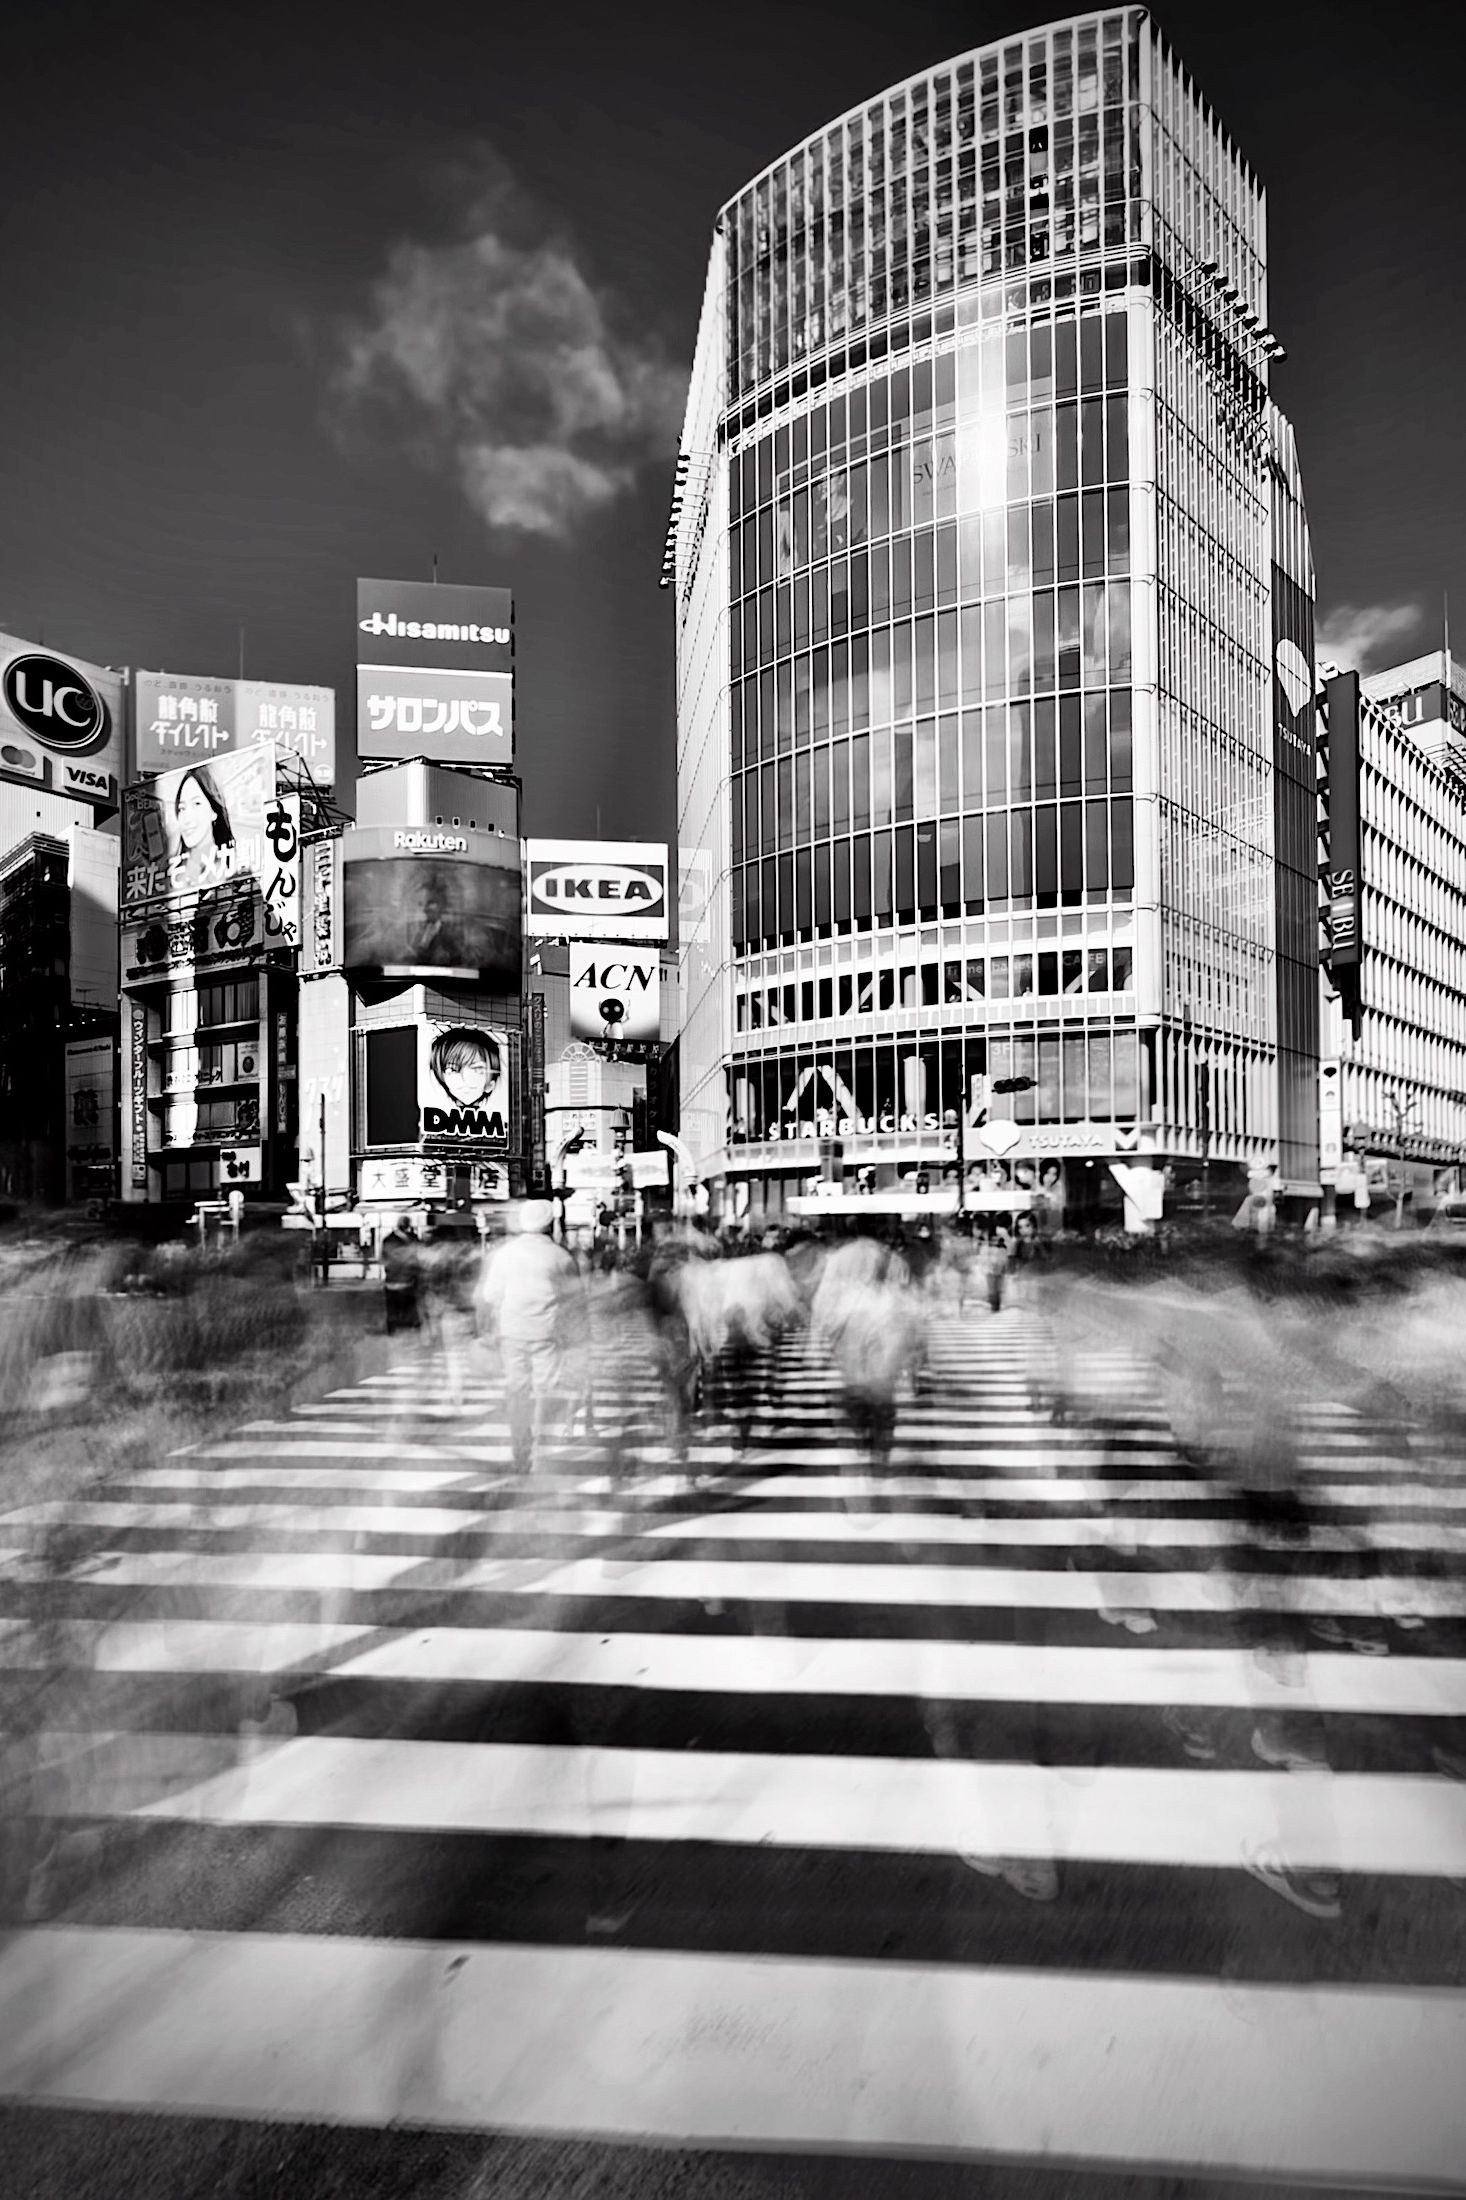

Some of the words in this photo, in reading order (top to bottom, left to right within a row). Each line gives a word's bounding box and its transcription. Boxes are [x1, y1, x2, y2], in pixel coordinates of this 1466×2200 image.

[359, 612, 510, 645] Hisamitsu
[367, 695, 504, 737] サロンパス
[1277, 722, 1312, 756] TSUTAYA
[64, 766, 108, 790] VISA
[393, 831, 468, 853] Rakuten
[265, 800, 298, 943] もんじゃ
[544, 878, 653, 901] IKEA
[573, 963, 656, 992] ACN
[424, 1106, 506, 1137] DMM
[768, 1112, 939, 1141] STARBUCKS
[1029, 1136, 1102, 1150] TSUTAYA
